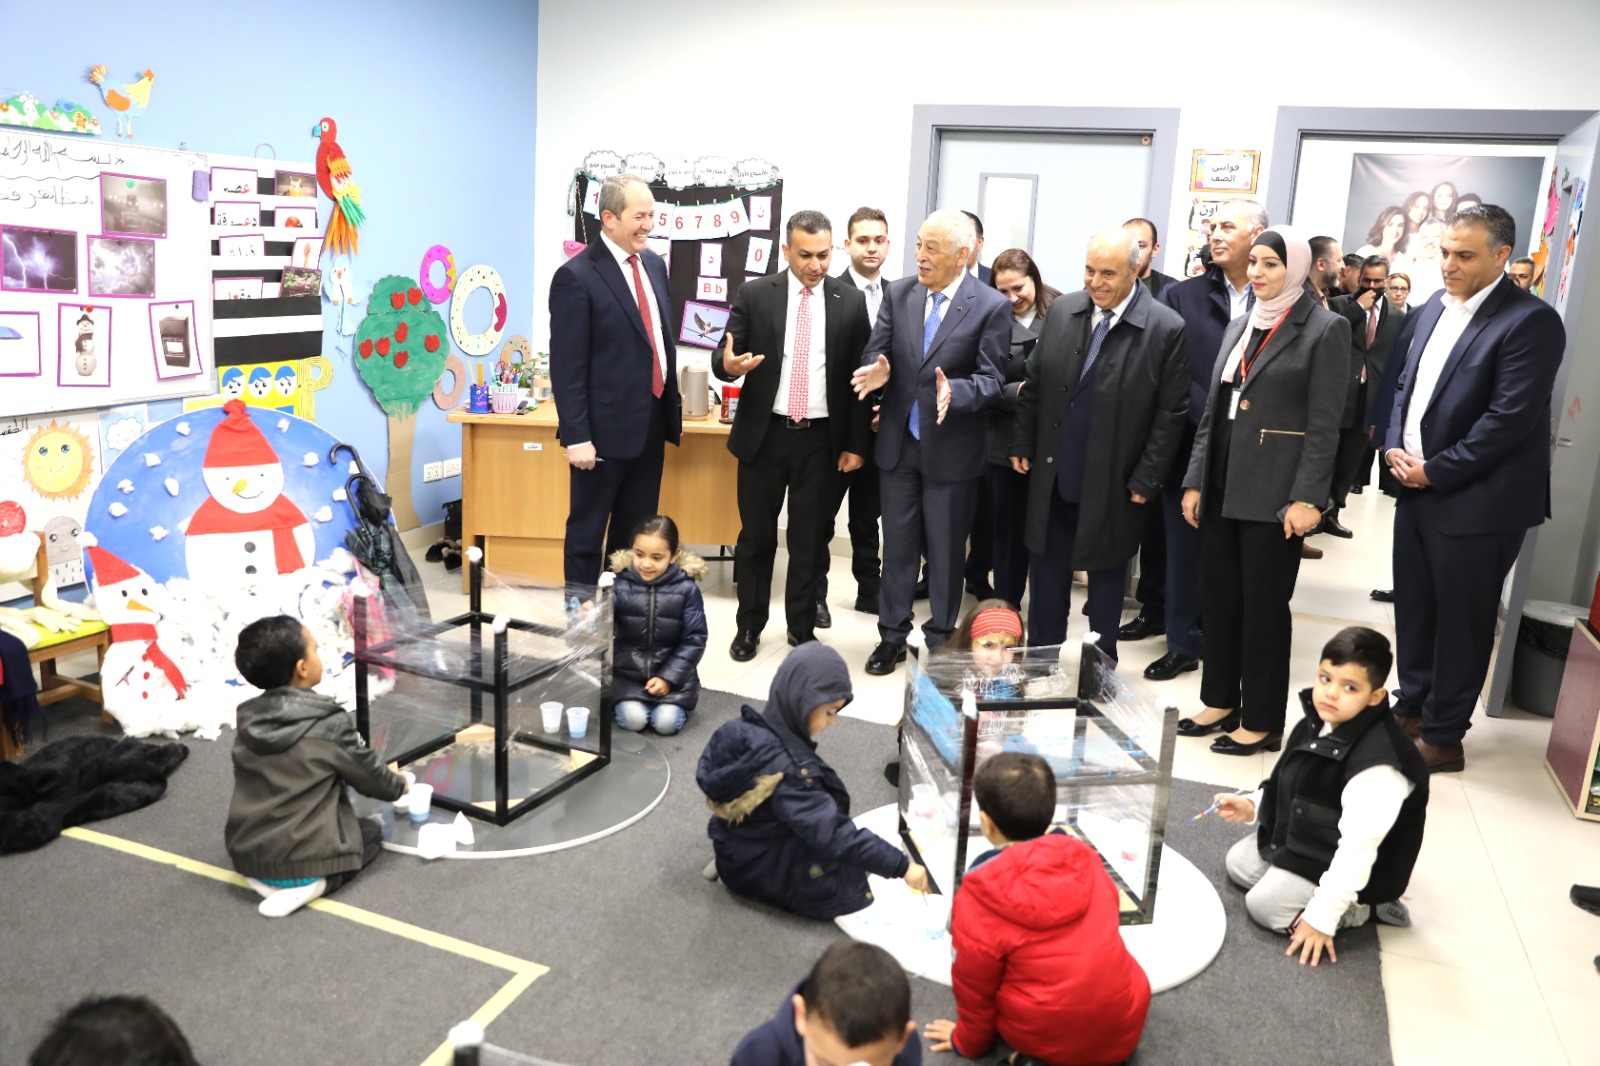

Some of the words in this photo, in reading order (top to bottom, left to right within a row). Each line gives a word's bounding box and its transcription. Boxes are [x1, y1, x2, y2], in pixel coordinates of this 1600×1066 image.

[592, 191, 600, 205] 1
[658, 213, 667, 226] 5
[675, 216, 684, 230] 6
[694, 215, 703, 229] 7
[713, 214, 722, 228] 8
[730, 210, 740, 224] 9
[754, 248, 763, 262] 0
[703, 282, 712, 293] B
[715, 283, 723, 294] b
